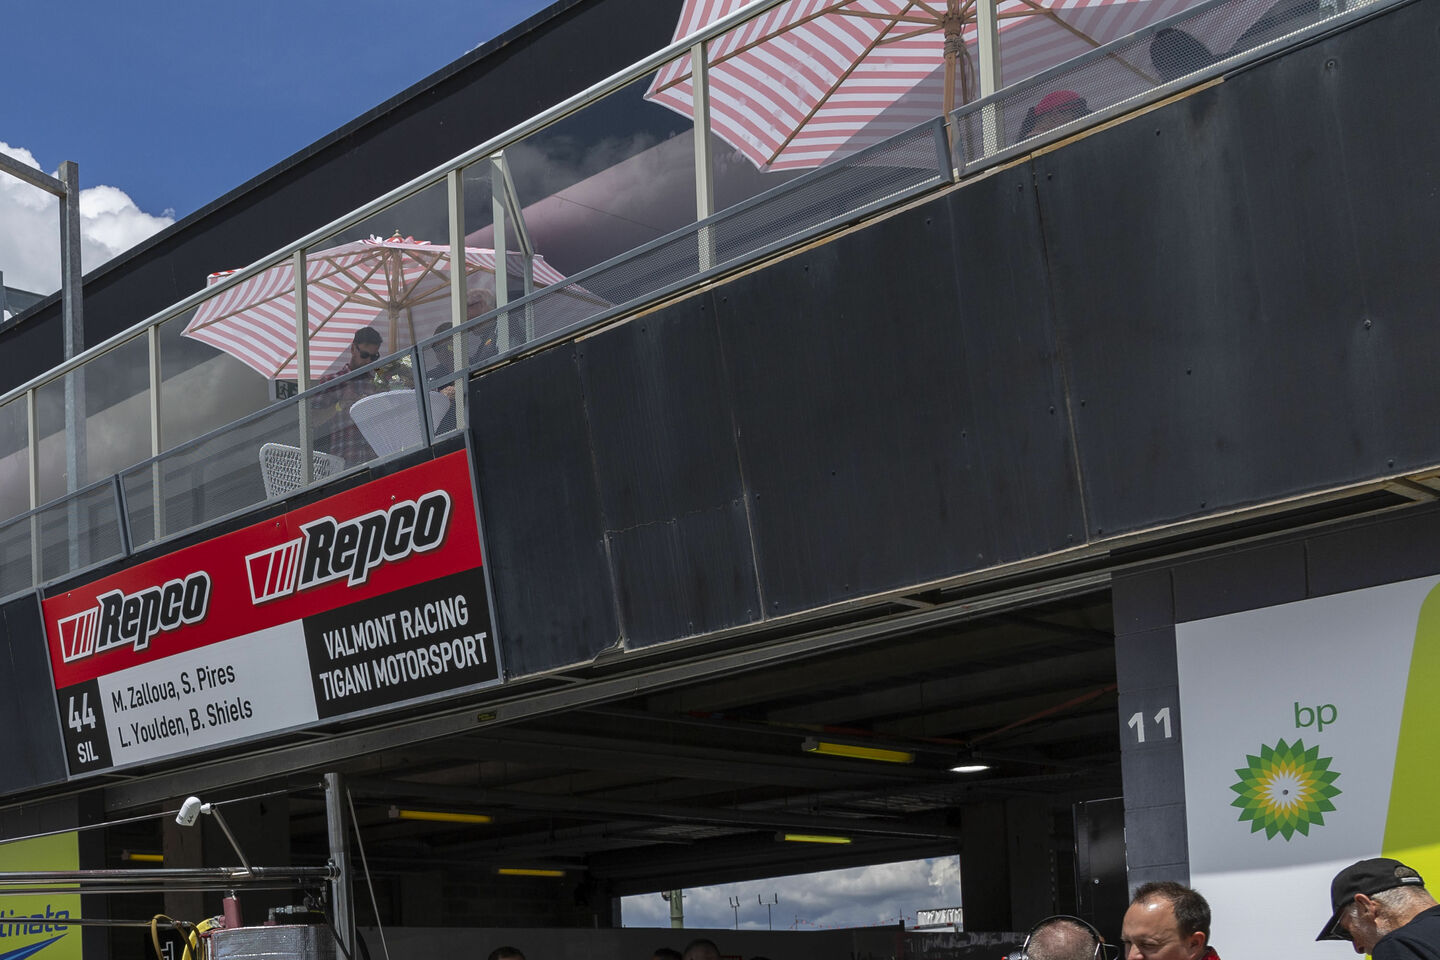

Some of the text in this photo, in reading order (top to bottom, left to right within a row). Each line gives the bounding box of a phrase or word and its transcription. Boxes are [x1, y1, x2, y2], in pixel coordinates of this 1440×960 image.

[298, 489, 451, 588] Repco
[97, 571, 211, 652] Repco
[323, 594, 469, 660] VALMONT RACING
[112, 664, 236, 713] M. Zalloua, S. Pires
[319, 632, 488, 701] TIGANI MOTORSPORT
[68, 692, 96, 733] 44
[120, 696, 253, 748] L. Youlden, B. Shiels
[1293, 702, 1338, 732] bp
[77, 741, 99, 764] SIL
